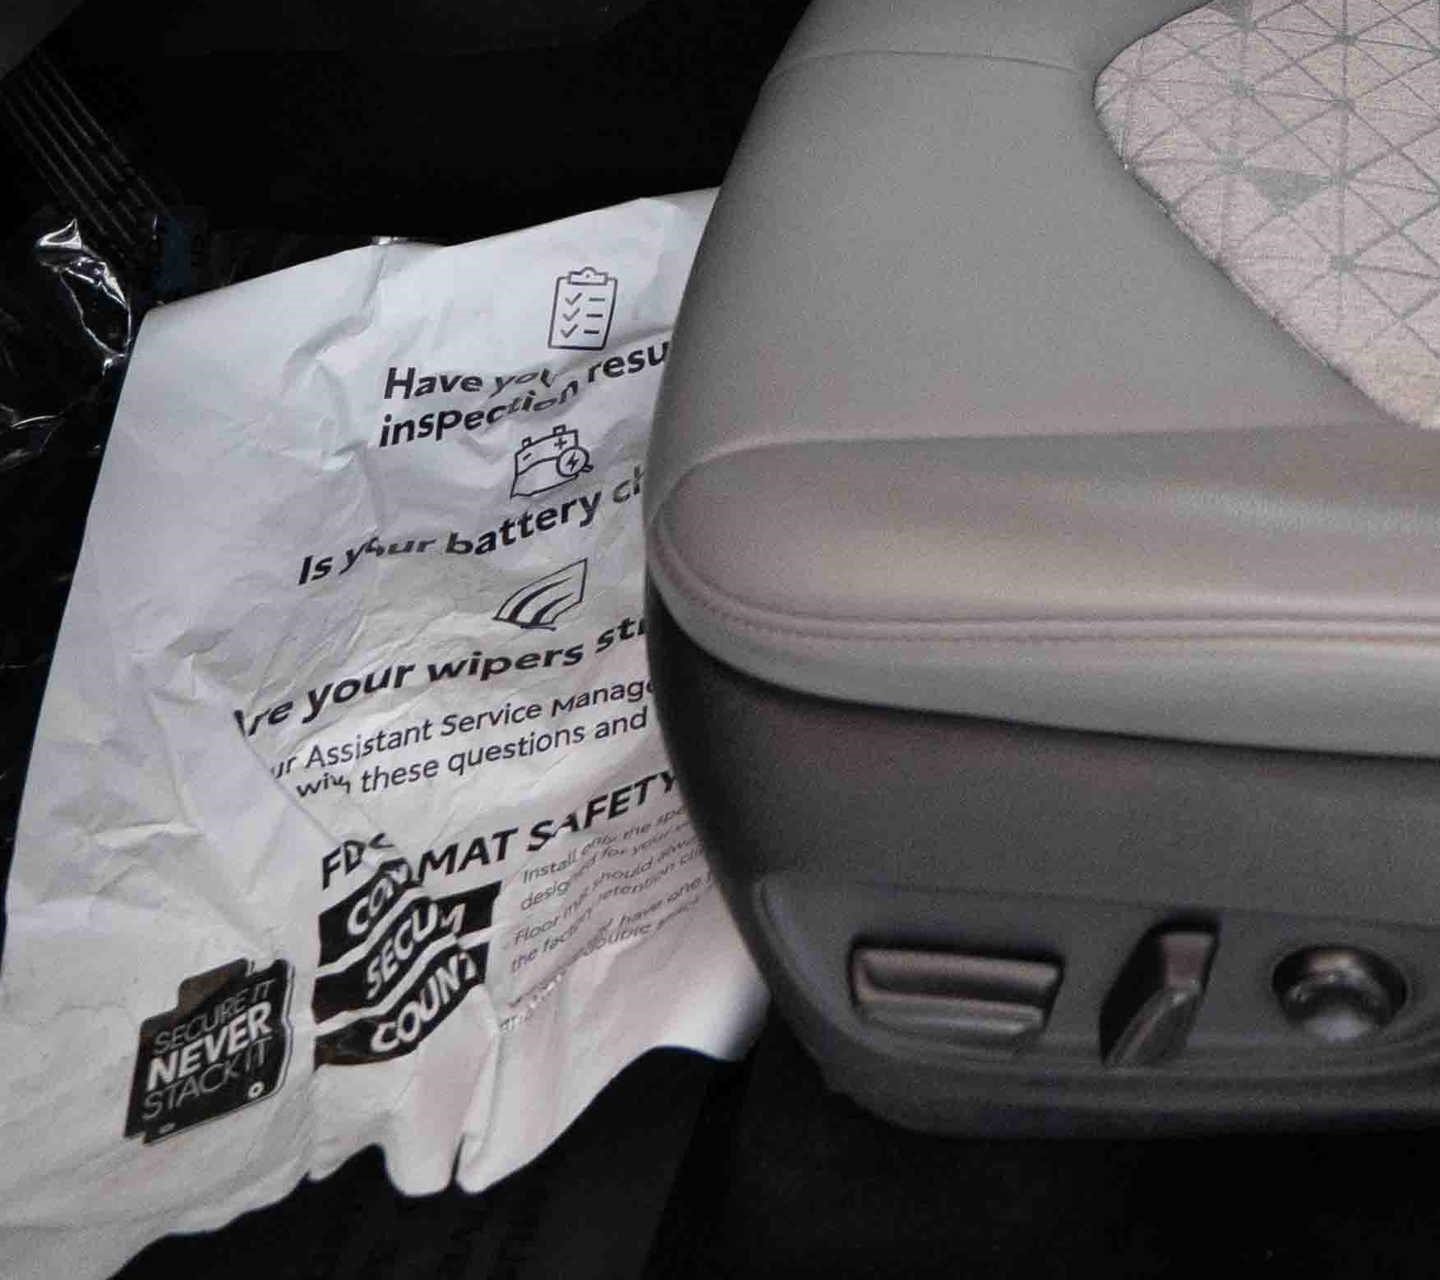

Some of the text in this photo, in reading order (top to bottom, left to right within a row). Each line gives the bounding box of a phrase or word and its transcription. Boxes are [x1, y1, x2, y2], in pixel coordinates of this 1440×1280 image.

[384, 367, 483, 400] Have
[588, 342, 669, 383] resu
[379, 379, 580, 447] inspection
[298, 555, 333, 585] Is
[445, 491, 602, 556] battery
[302, 662, 415, 723] your
[427, 643, 584, 683] wipers
[304, 719, 434, 769] Assistant
[440, 700, 542, 737] Service
[551, 678, 657, 718] Manag
[361, 760, 440, 794] these
[448, 726, 585, 776] questions
[594, 706, 648, 741] and
[417, 827, 519, 882] MAT
[147, 1001, 273, 1091] NEVER
[153, 978, 277, 1055] SECURE IT
[142, 1036, 273, 1120] STACK IT
